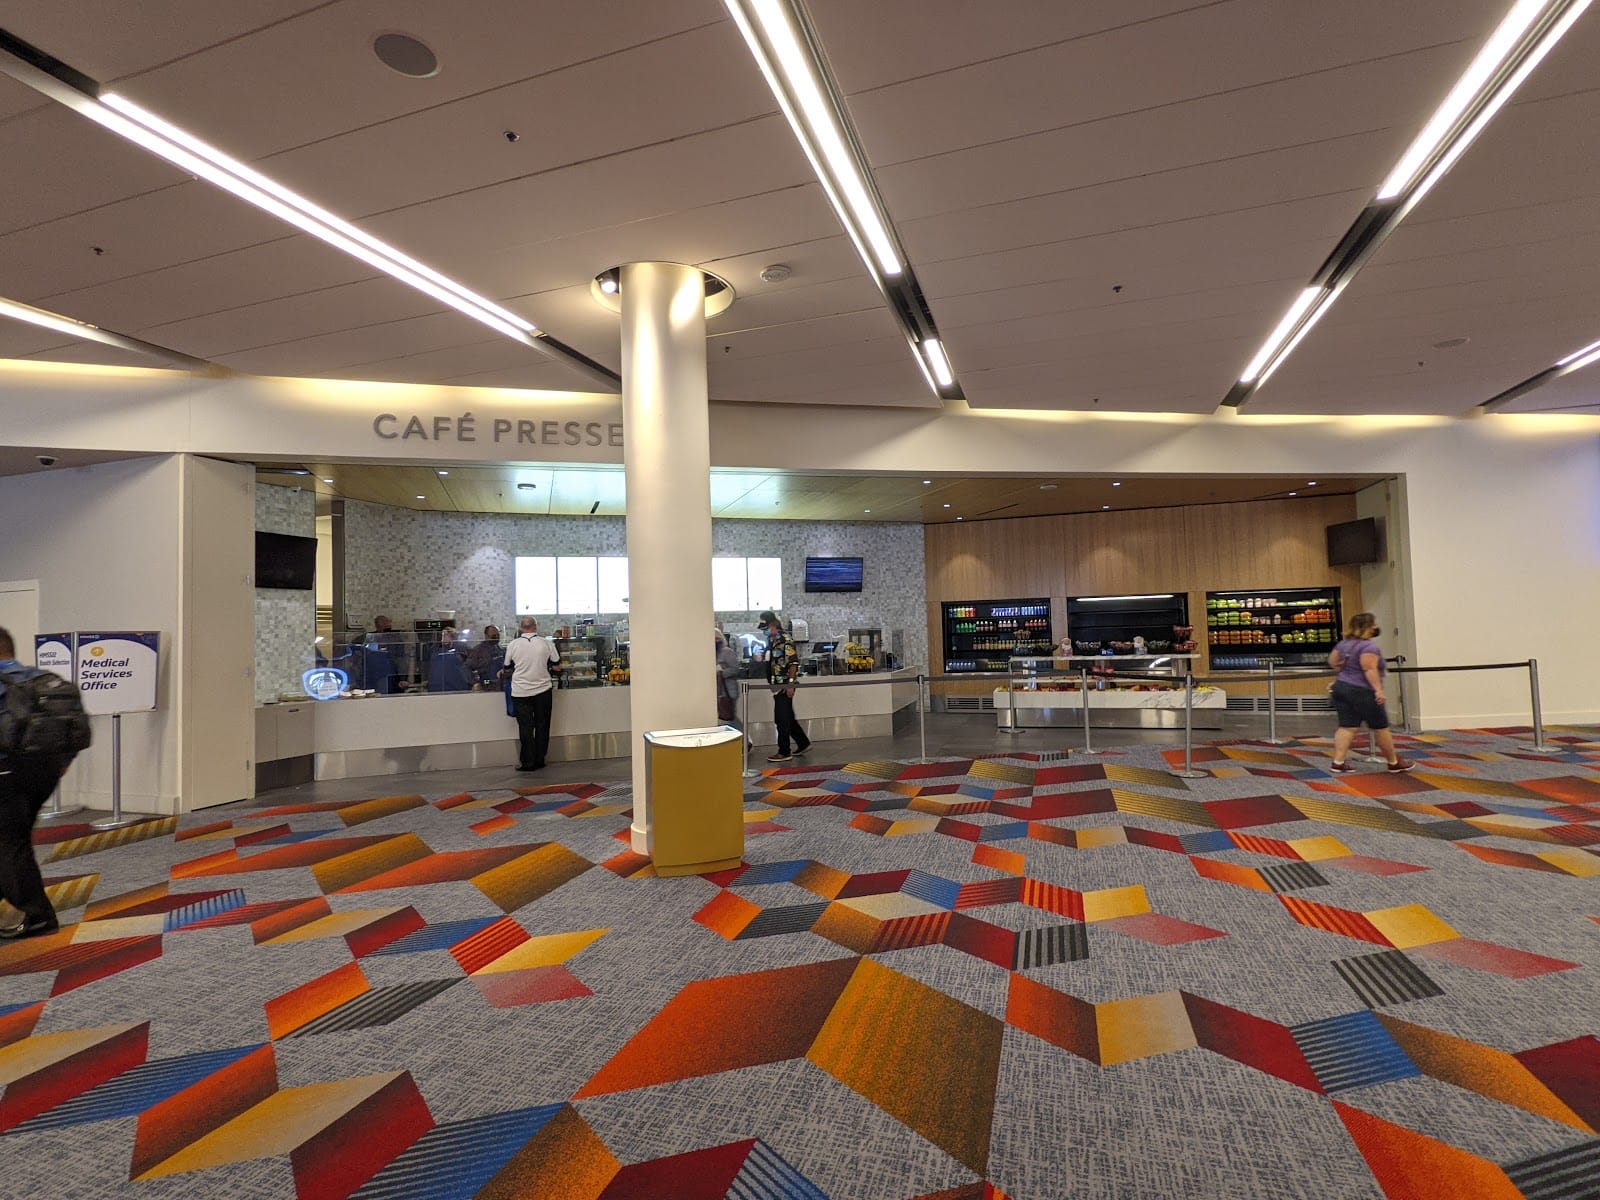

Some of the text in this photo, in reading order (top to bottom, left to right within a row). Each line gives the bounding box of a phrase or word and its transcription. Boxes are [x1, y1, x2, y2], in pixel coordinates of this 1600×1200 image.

[373, 412, 624, 446] CAFÉ PRESSE
[81, 658, 130, 668] Medical
[80, 669, 133, 679] Services
[80, 680, 118, 691] Office
